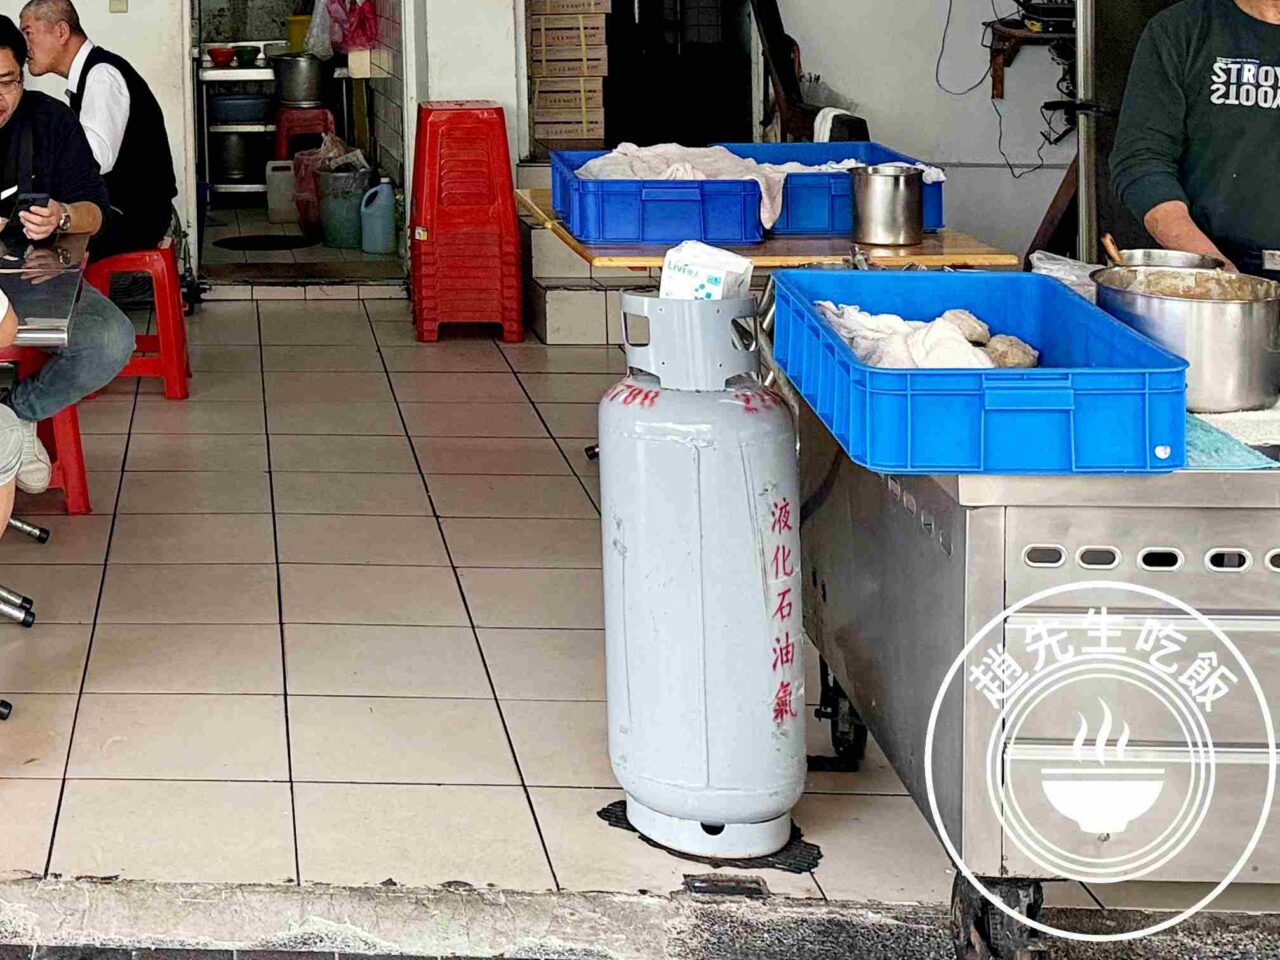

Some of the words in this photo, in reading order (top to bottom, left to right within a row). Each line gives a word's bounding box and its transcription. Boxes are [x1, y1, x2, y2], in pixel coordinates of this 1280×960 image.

[771, 498, 797, 722] 液化石油氣
